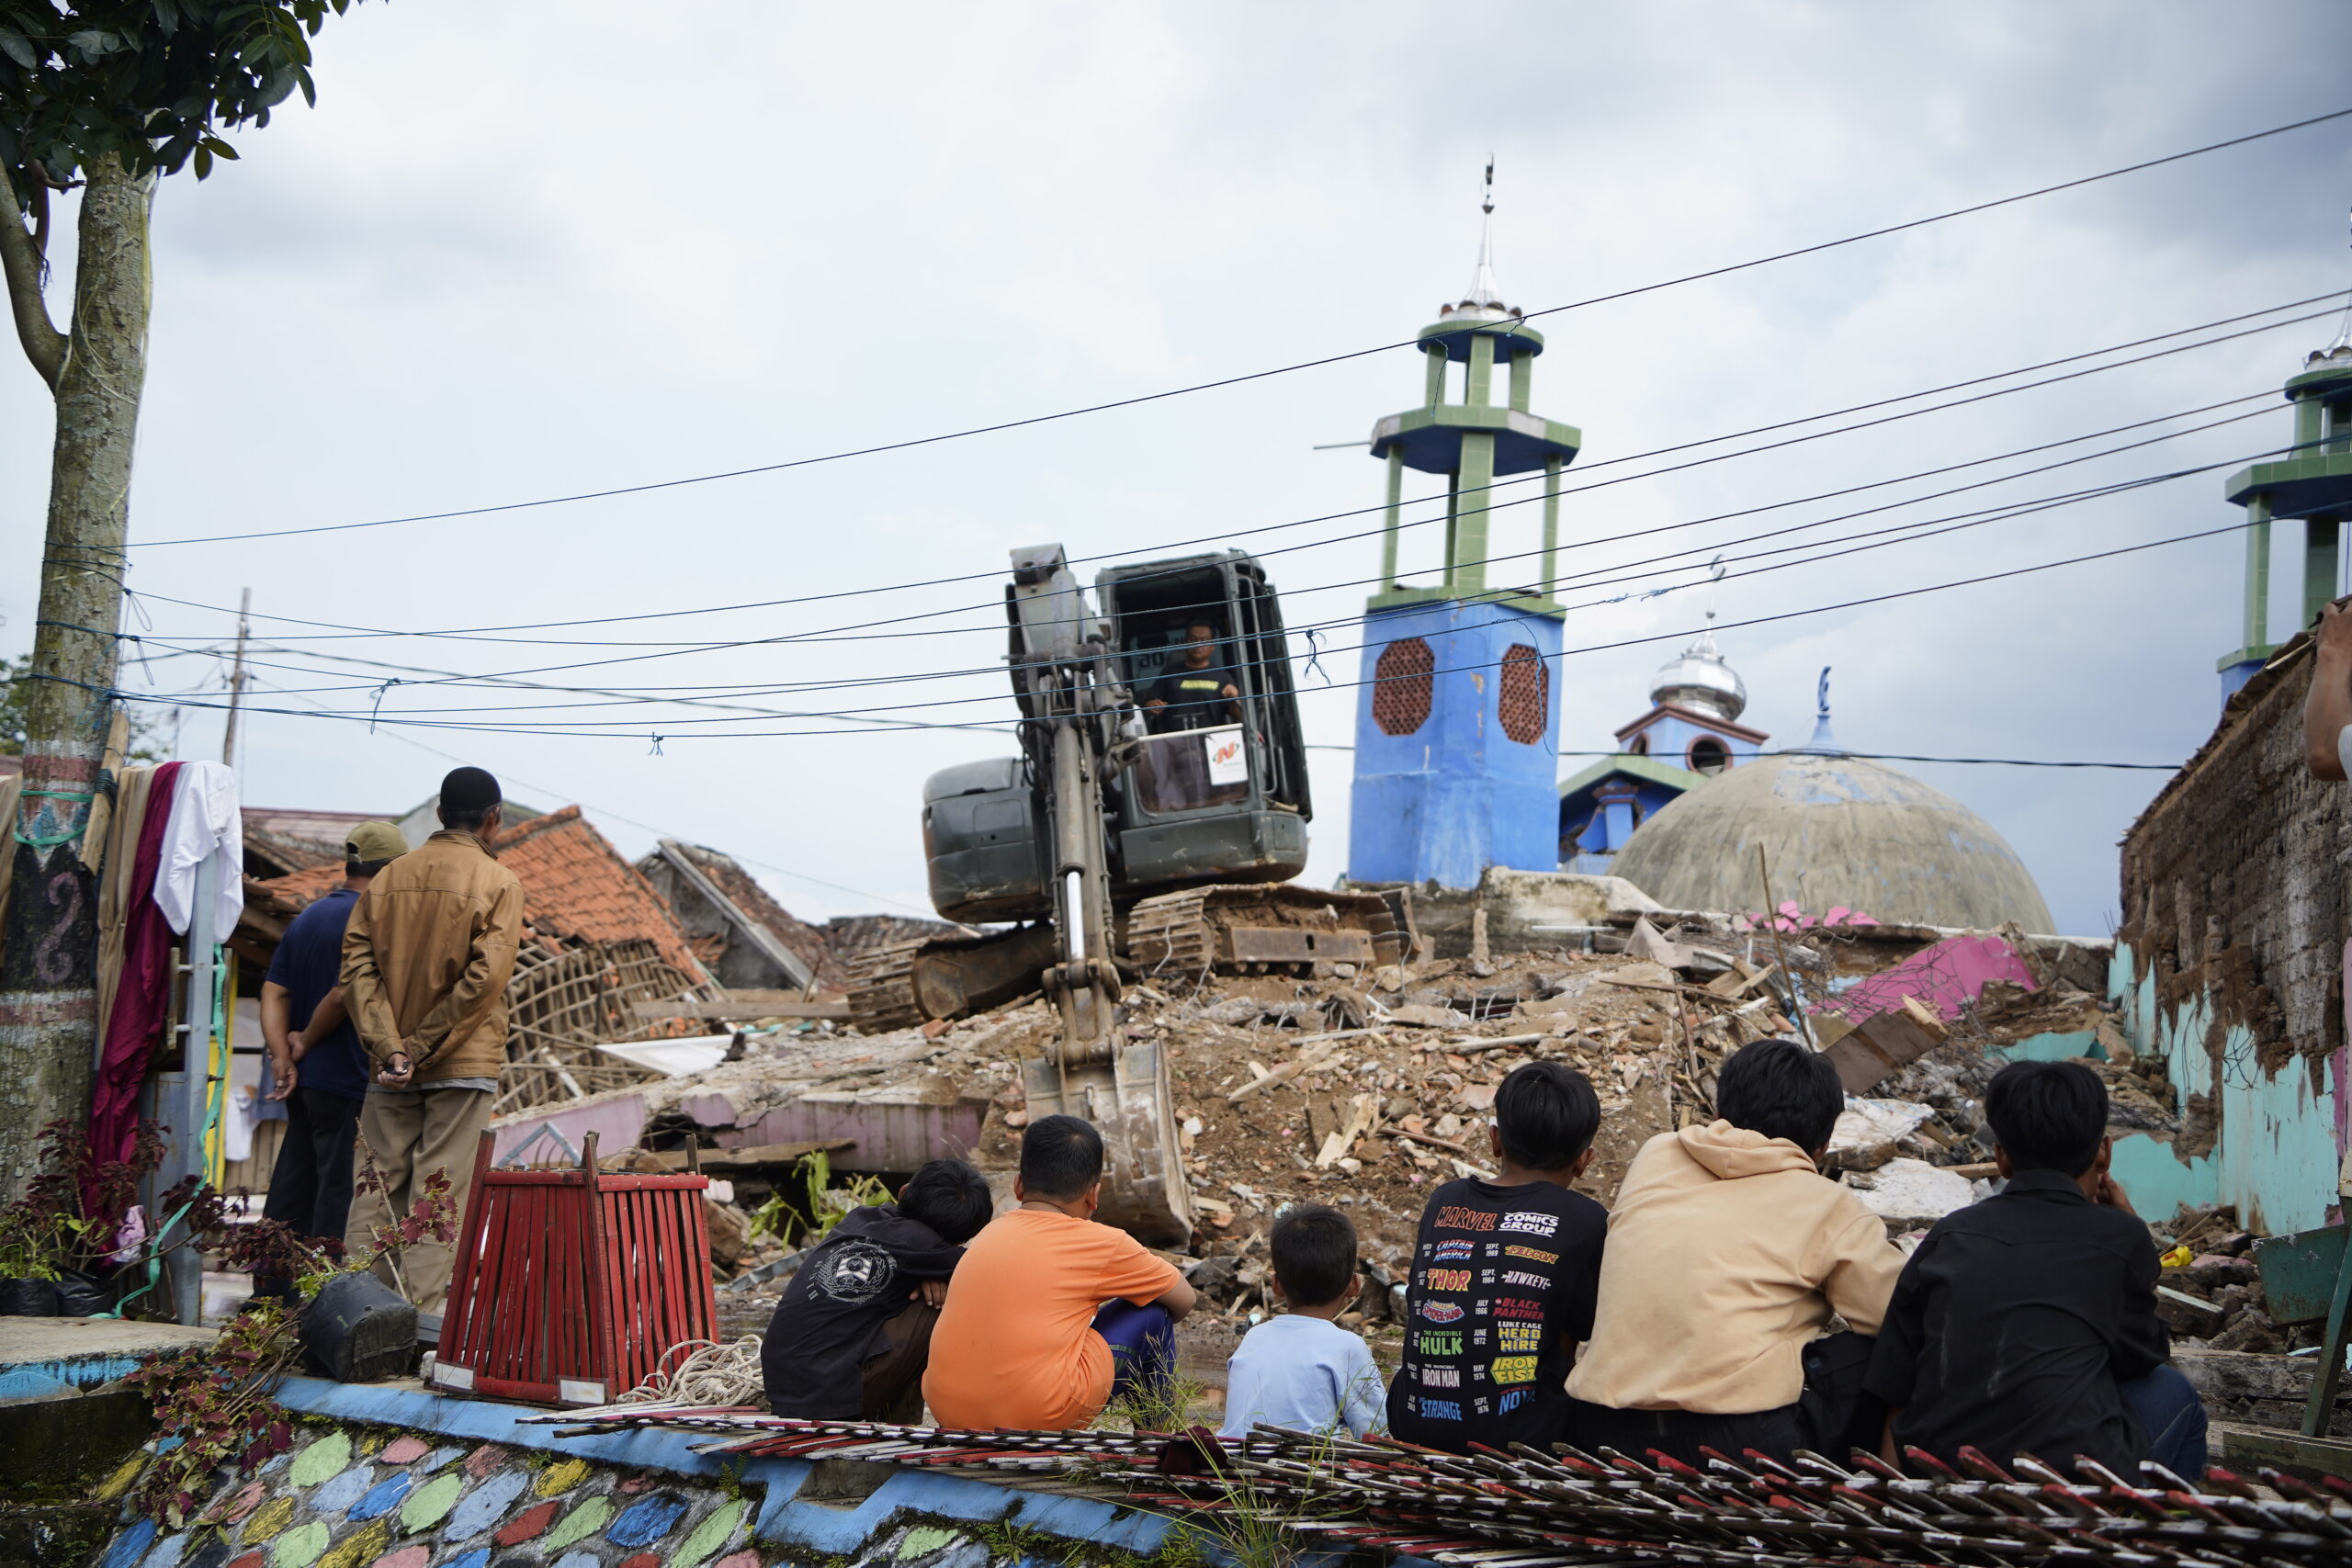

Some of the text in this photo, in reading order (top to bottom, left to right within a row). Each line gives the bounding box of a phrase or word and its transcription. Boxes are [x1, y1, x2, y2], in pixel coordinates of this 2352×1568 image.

[1434, 1206, 1498, 1231] MARVEL
[1504, 1213, 1559, 1227] COMICS
[1500, 1222, 1555, 1235] GROUP
[1437, 1239, 1476, 1251] CAPTAIN
[1433, 1249, 1472, 1262] AMERICA
[1507, 1245, 1559, 1264] FALCON
[1428, 1269, 1472, 1292] THOR
[1503, 1270, 1551, 1289] HAWKEYE
[1476, 1299, 1488, 1307] JULY
[1501, 1297, 1542, 1310] BLACK
[1492, 1307, 1544, 1320] PANTHER
[1498, 1327, 1541, 1340] HERO
[1420, 1337, 1464, 1355] HULK
[1500, 1340, 1538, 1352] HIRE
[1473, 1364, 1485, 1372] MAY
[1491, 1357, 1538, 1371] IRON
[1422, 1369, 1441, 1387] IRON
[1442, 1370, 1460, 1388] MAN
[1474, 1372, 1485, 1381] 1974
[1495, 1369, 1536, 1383] FIST
[1474, 1396, 1488, 1406] SEPT.
[1421, 1400, 1463, 1421] STRANGE
[1477, 1405, 1489, 1414] 1976
